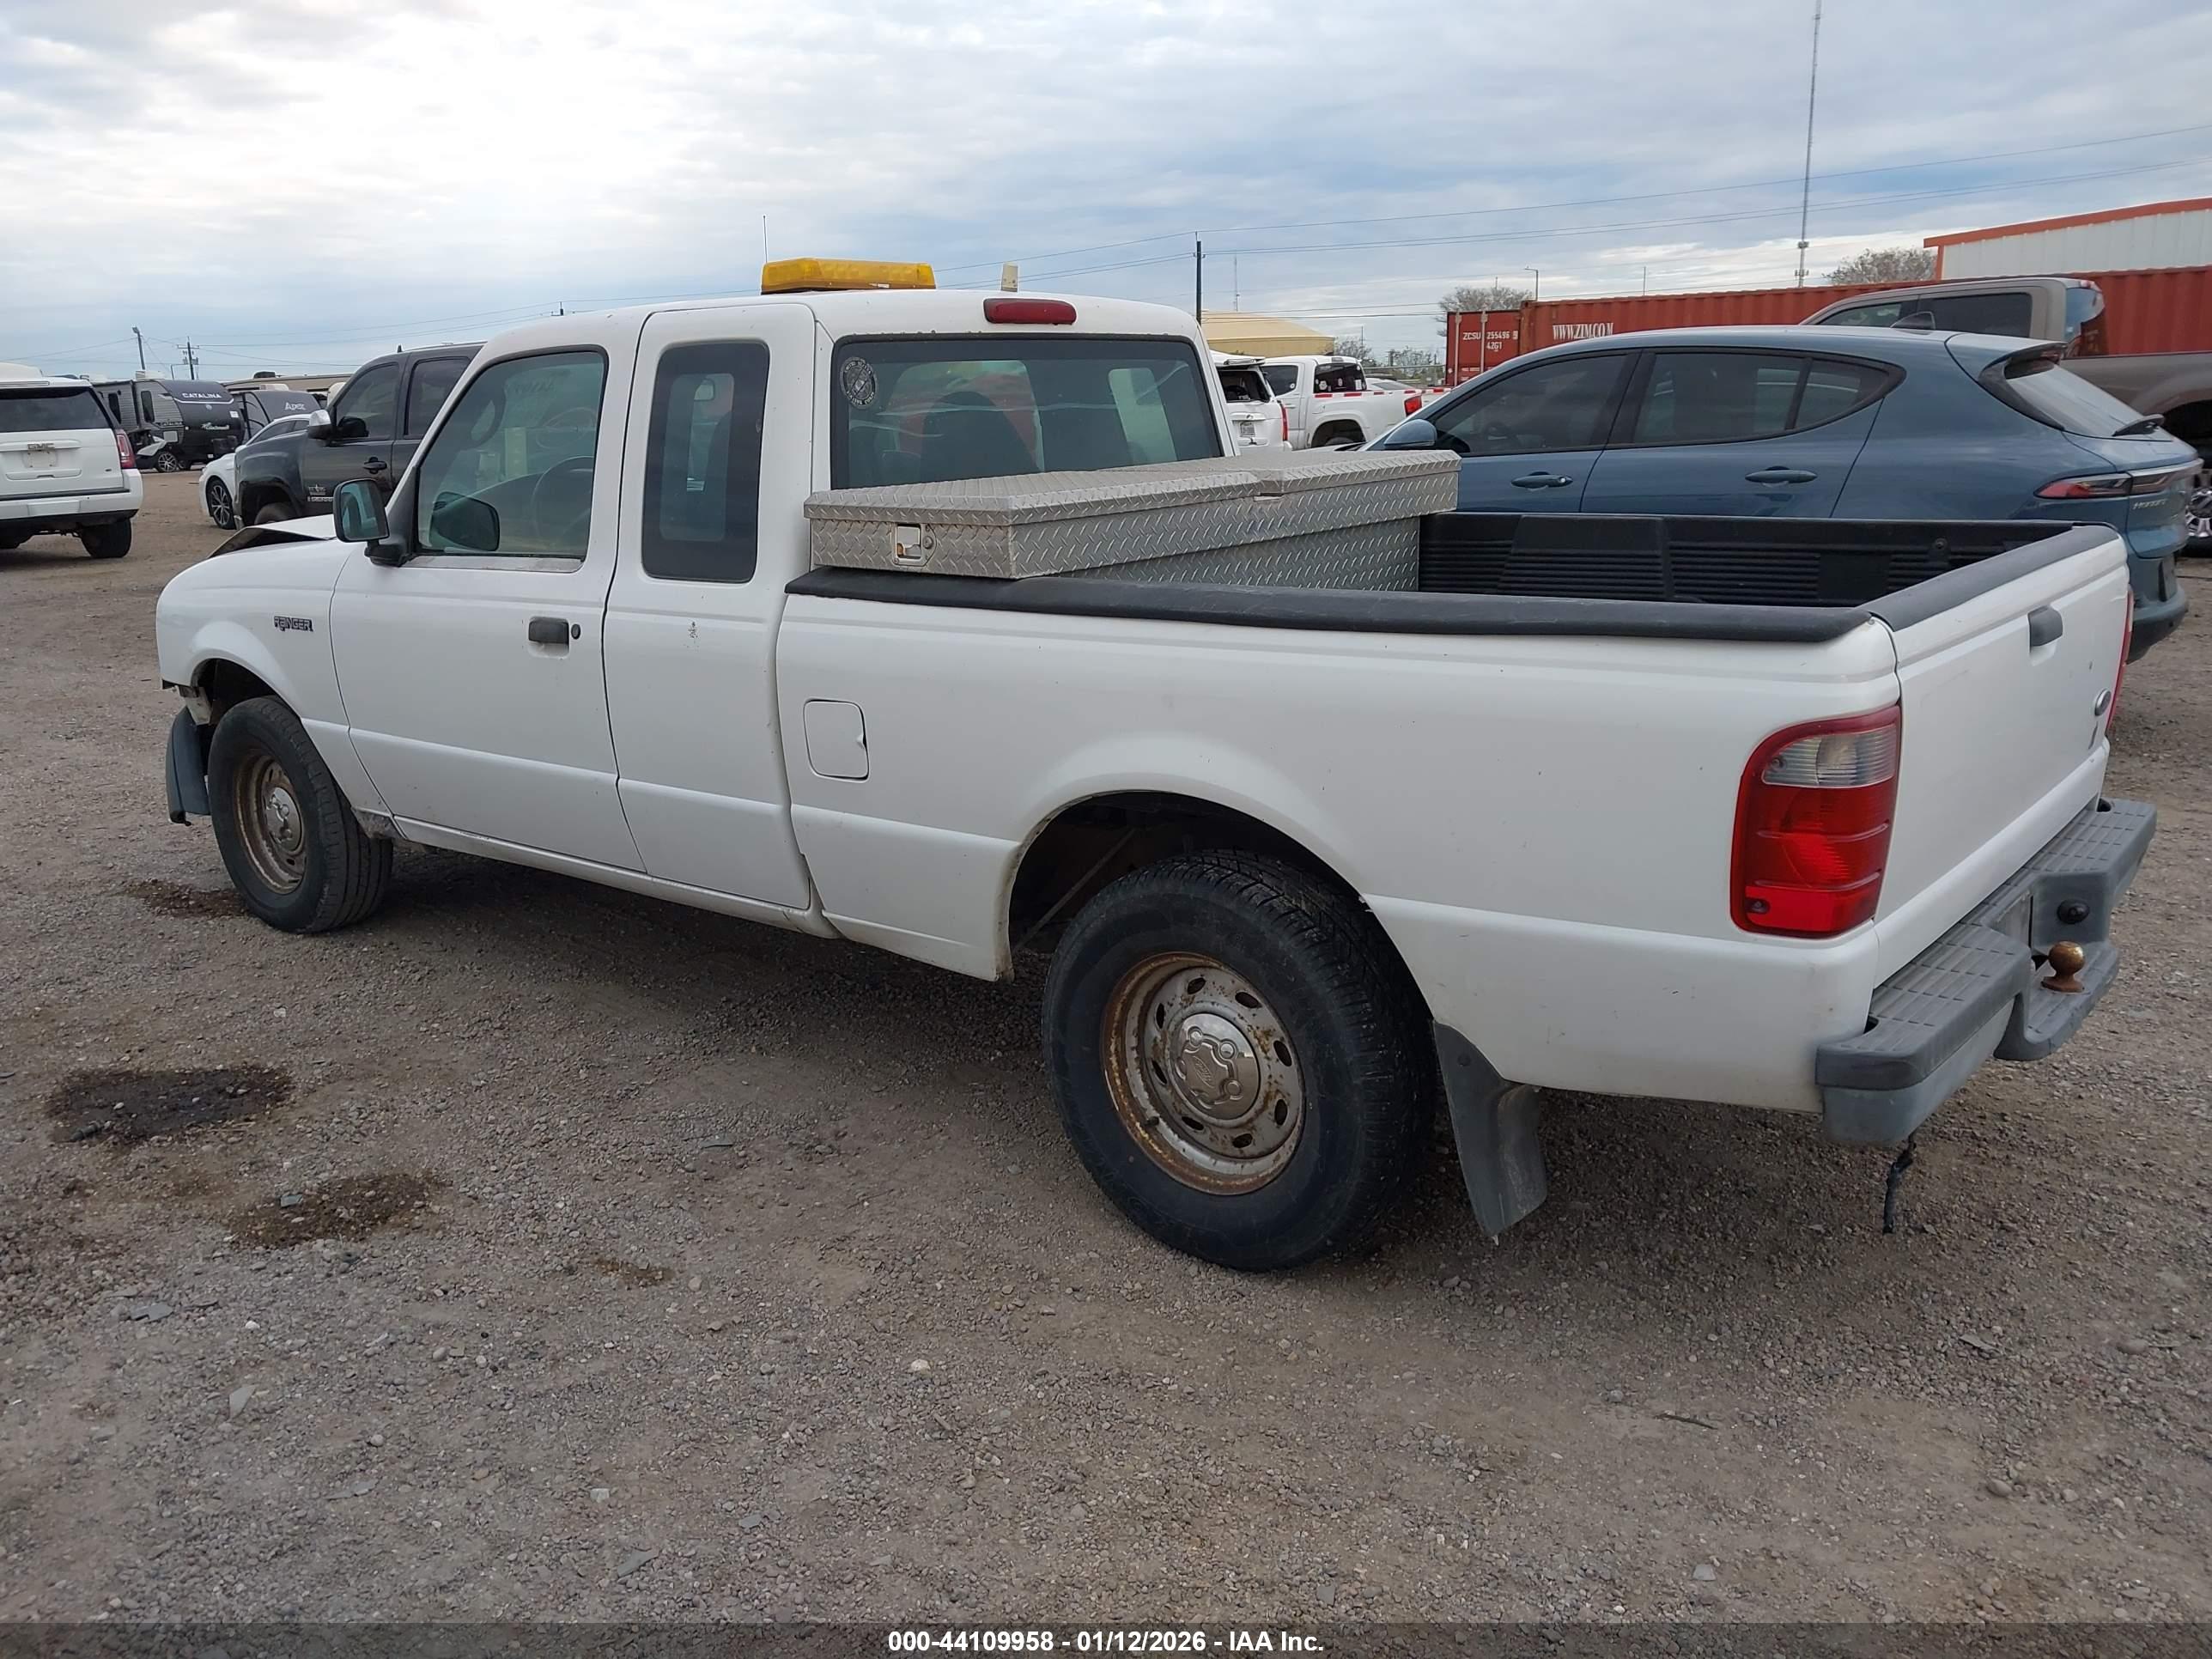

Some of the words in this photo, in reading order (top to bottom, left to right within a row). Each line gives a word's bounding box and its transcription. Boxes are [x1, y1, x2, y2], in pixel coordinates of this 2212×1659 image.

[1462, 331, 1481, 340] ZCSU
[1486, 341, 1502, 349] 42G1
[27, 441, 56, 450] GMC
[274, 616, 313, 631] RANGER
